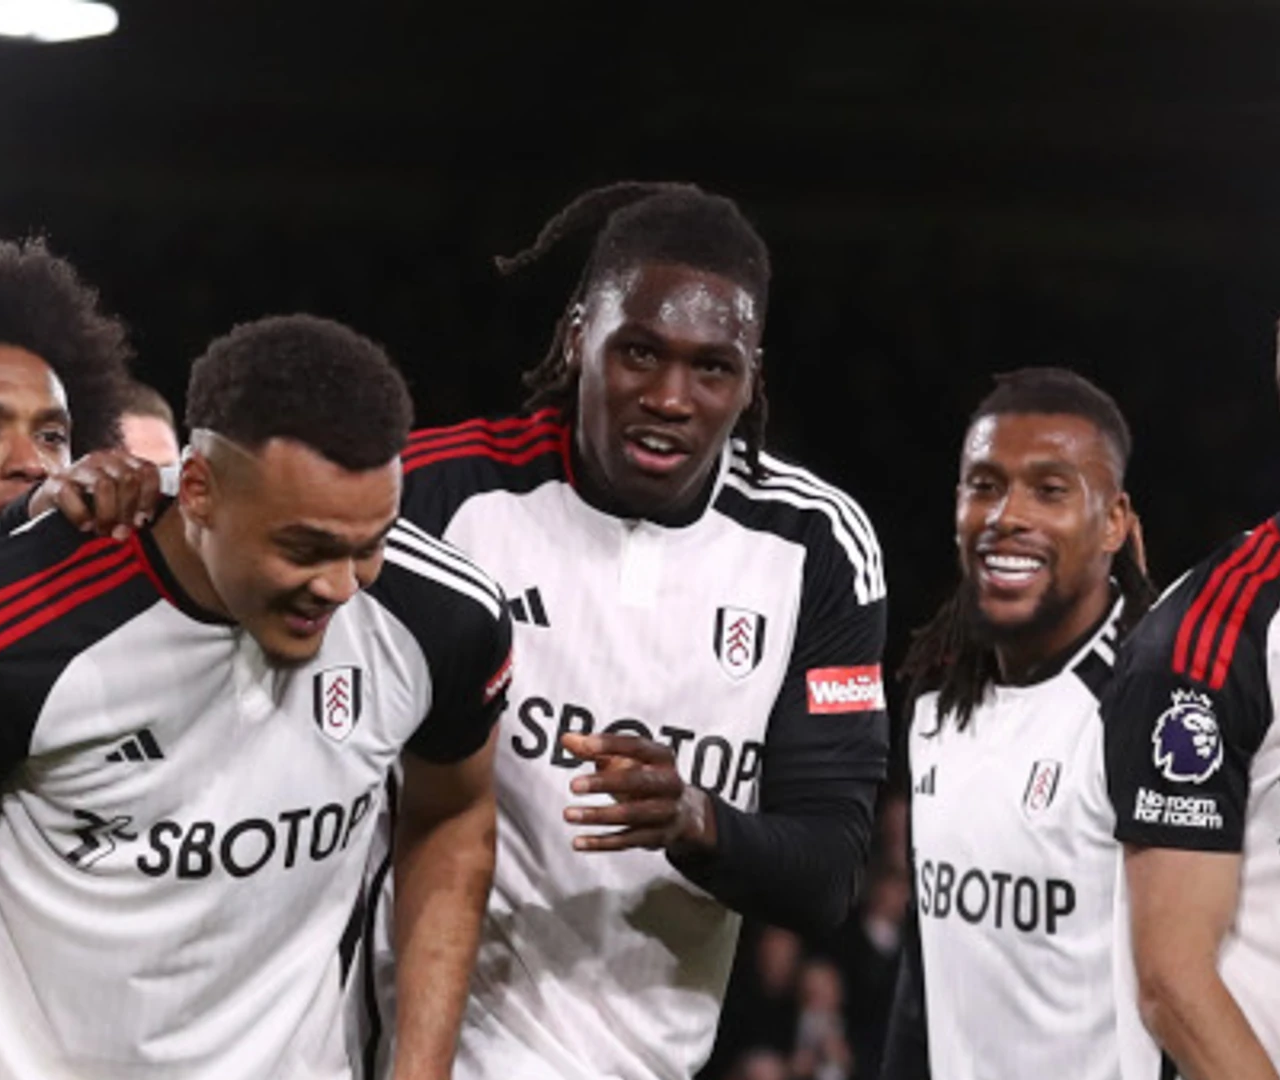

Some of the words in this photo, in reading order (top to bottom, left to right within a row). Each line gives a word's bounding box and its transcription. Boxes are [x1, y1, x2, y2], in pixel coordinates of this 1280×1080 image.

[1134, 808, 1162, 823] for
[1137, 787, 1165, 809] No
[1166, 796, 1217, 813] room
[136, 790, 373, 879] SBOTOP
[921, 859, 1077, 935] SBOTOP
